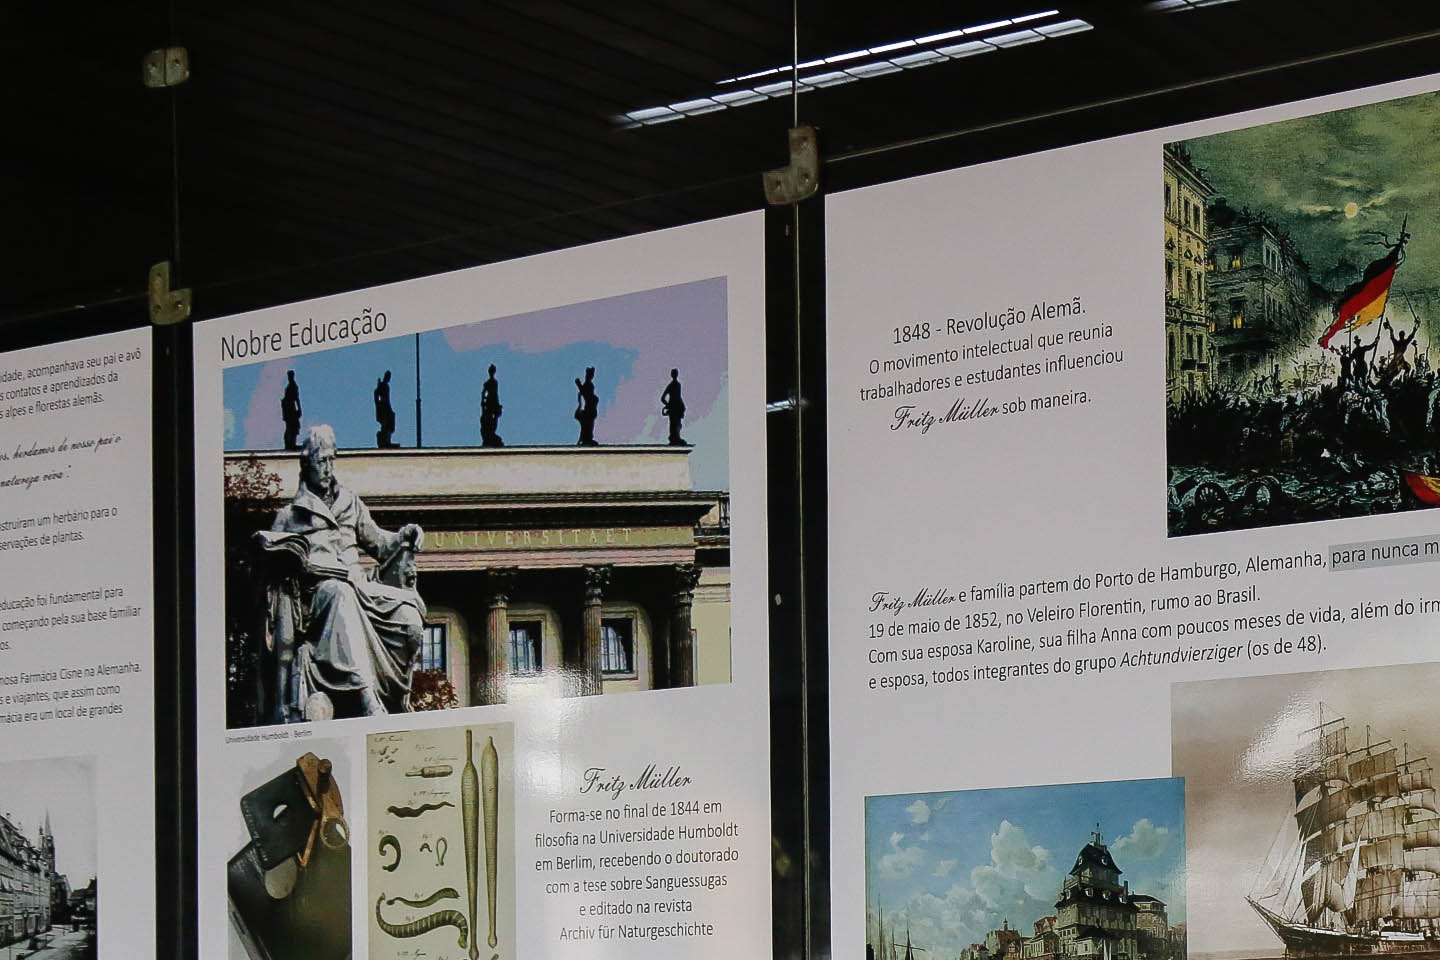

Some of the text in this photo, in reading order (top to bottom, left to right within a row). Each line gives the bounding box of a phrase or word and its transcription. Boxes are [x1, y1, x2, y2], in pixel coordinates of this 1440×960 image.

[222, 308, 387, 361] Nobre Educação
[894, 323, 930, 344] 1848
[947, 307, 1025, 335] Revolução
[1030, 297, 1085, 322] Alemã.
[27, 360, 84, 378] acompanhava
[86, 358, 102, 369] seu
[104, 352, 116, 368] pai
[118, 354, 124, 362] e
[870, 323, 1112, 374] O movimento intelectual que reunia
[860, 350, 1122, 400] trabalhadores e estudantes influenciou
[891, 390, 1091, 434] Fritz Müller sob maneira.
[869, 592, 906, 616] Fritz
[908, 588, 956, 608] Müller
[959, 592, 966, 602] e
[970, 583, 1014, 601] família
[1020, 581, 1068, 600] partem
[1073, 575, 1090, 590] do
[1096, 572, 1133, 588] Porto
[1138, 568, 1155, 583] de
[1161, 562, 1240, 581] Hamburgo,
[1246, 551, 1326, 573] Alemanha,
[1333, 550, 1365, 568] para
[1372, 544, 1418, 560] nunca
[2, 606, 141, 631] começando pela sua base familiar
[580, 766, 692, 800] Fritz Müller
[550, 801, 721, 822] Forma-se no final de 1844 em
[536, 822, 738, 847] filosofia na Universidade Humboldt
